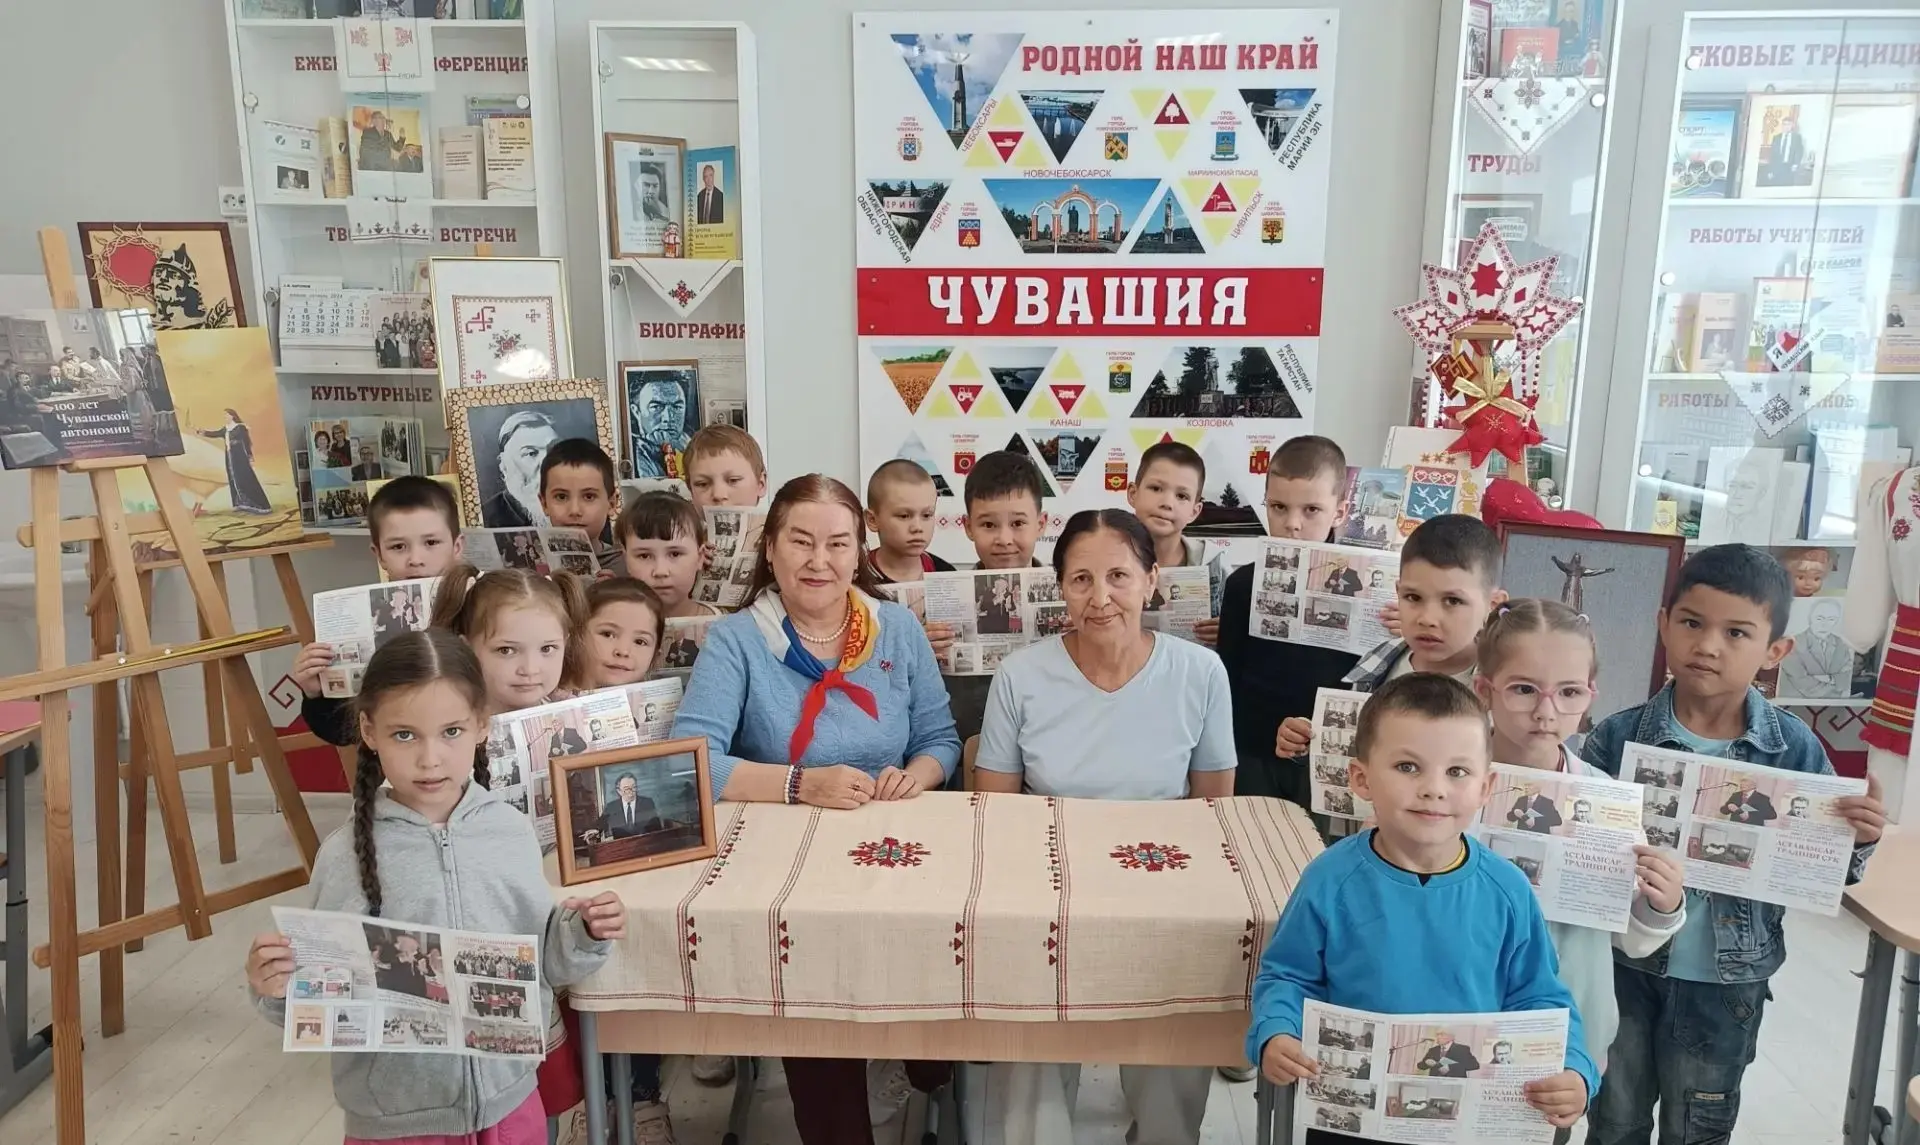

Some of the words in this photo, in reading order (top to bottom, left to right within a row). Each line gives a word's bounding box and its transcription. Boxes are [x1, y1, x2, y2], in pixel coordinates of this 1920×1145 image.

[433, 56, 529, 73] ФЕРЕНЦИЯ
[1022, 38, 1143, 75] РОДНОЙ
[1155, 44, 1227, 72] НАШ
[1237, 36, 1319, 70] КРАЙ
[961, 98, 998, 152] ЧЕБОКСАРЫ
[1278, 102, 1322, 164] РЕСПУБЛИКА
[1287, 137, 1313, 171] МАРИЙ
[1311, 121, 1323, 136] ЭЛ
[1023, 169, 1111, 178] НОВОЧЕБОКСАРСК
[1467, 154, 1541, 175] ТРУДЫ
[857, 195, 882, 236] ОБЛАСТЬ
[930, 202, 952, 232] ЯДРИН
[1230, 191, 1264, 239] ЦИВИЛЬСК
[325, 226, 350, 242] ТВ
[440, 227, 518, 243] ВСТРЕЧИ
[865, 189, 912, 264] НИЖЕГОРОДСКАЯ
[1688, 228, 1762, 243] РАБОТЫ
[1769, 226, 1865, 243] УЧИТЕЛЕЙ
[927, 276, 1249, 325] ЧУВАШИЯ
[639, 323, 745, 339] БИОГРАФИЯ
[1275, 348, 1302, 391] ТАТАРСТАН
[1283, 343, 1314, 394] РЕСПУБЛИКА
[311, 386, 433, 402] КУЛЬТУРНЫЕ
[1658, 393, 1729, 408] РАБОТЫ
[54, 402, 74, 411] 100
[78, 401, 99, 410] лет
[56, 410, 130, 427] Чувашской
[1050, 418, 1082, 427] КАНАШ
[60, 426, 131, 438] автономии
